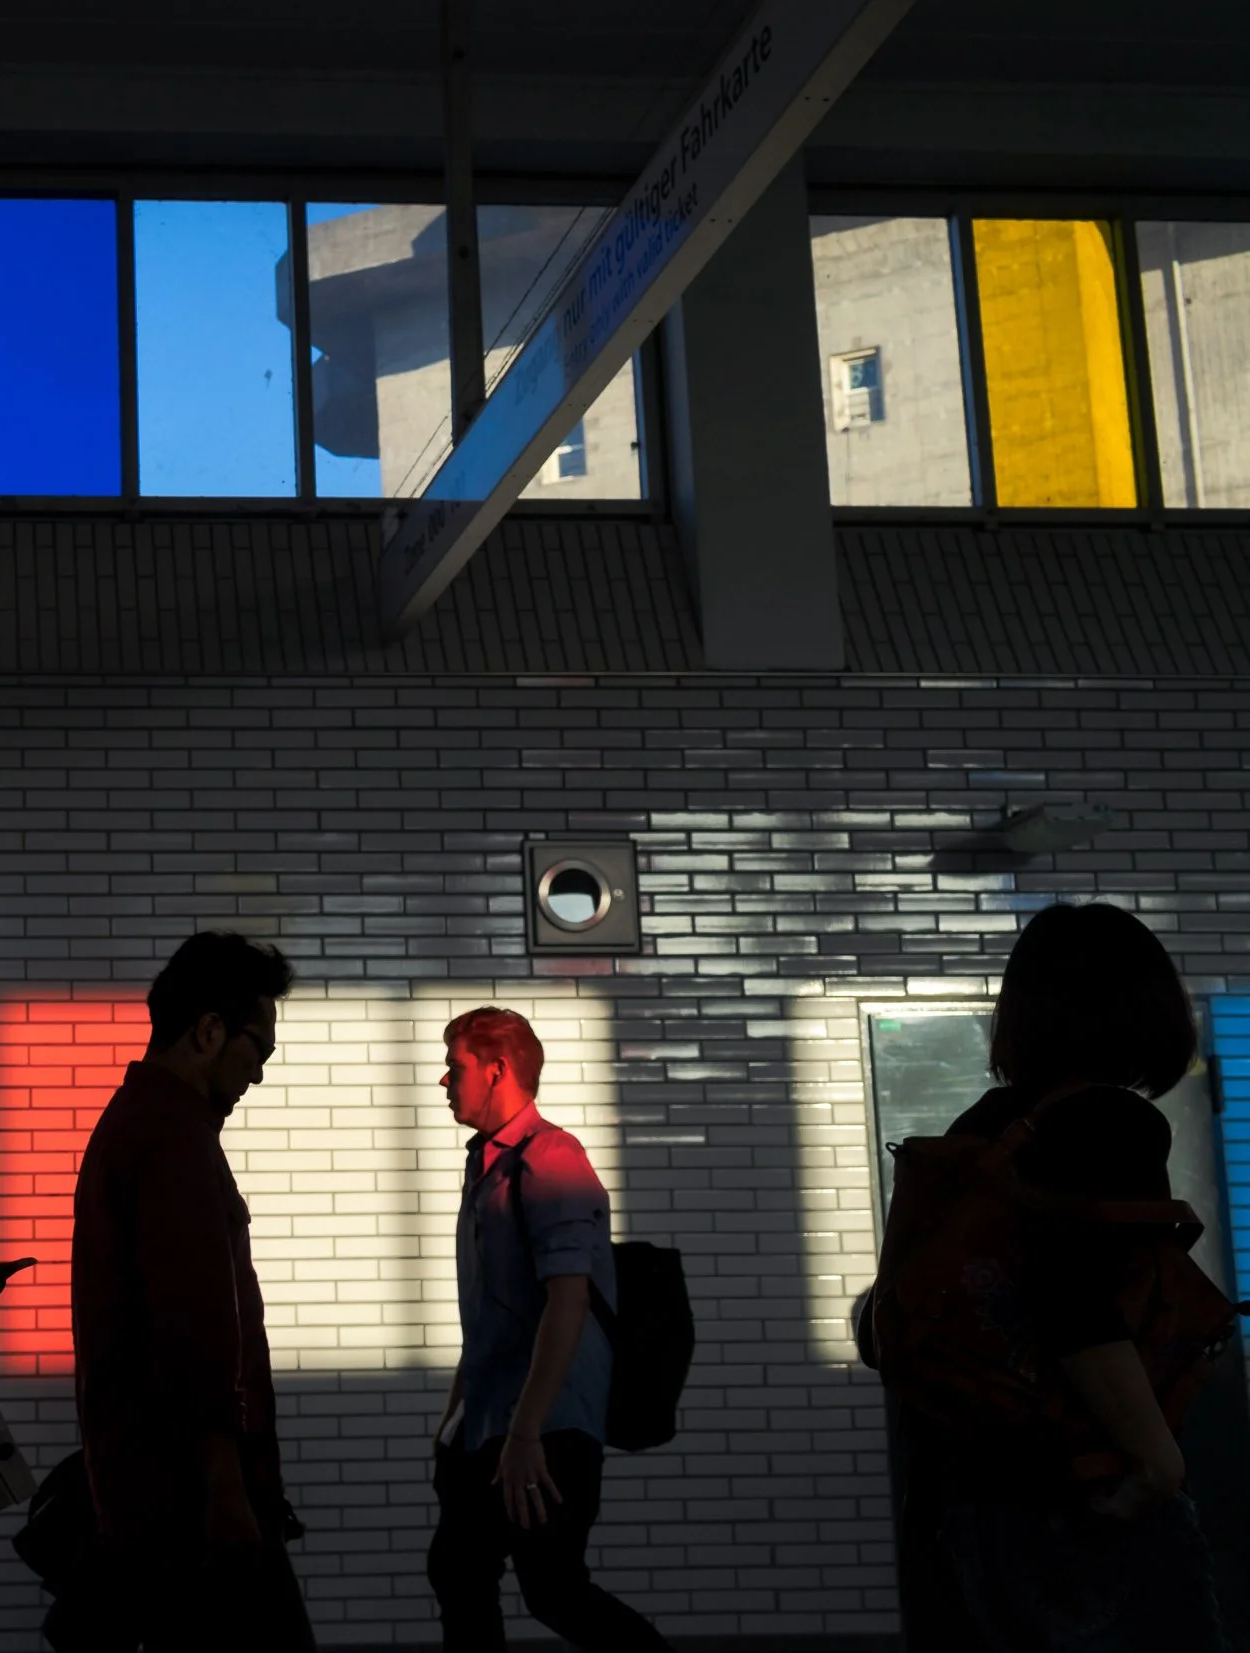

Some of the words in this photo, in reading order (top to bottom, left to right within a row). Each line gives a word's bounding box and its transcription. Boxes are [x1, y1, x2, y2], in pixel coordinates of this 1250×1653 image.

[563, 289, 587, 333] nur
[588, 243, 614, 298] mit
[615, 161, 678, 268] gültiger
[680, 25, 773, 173] Fahrkarte
[612, 268, 637, 315] with
[636, 223, 664, 280] valid
[664, 183, 699, 245] ticket
